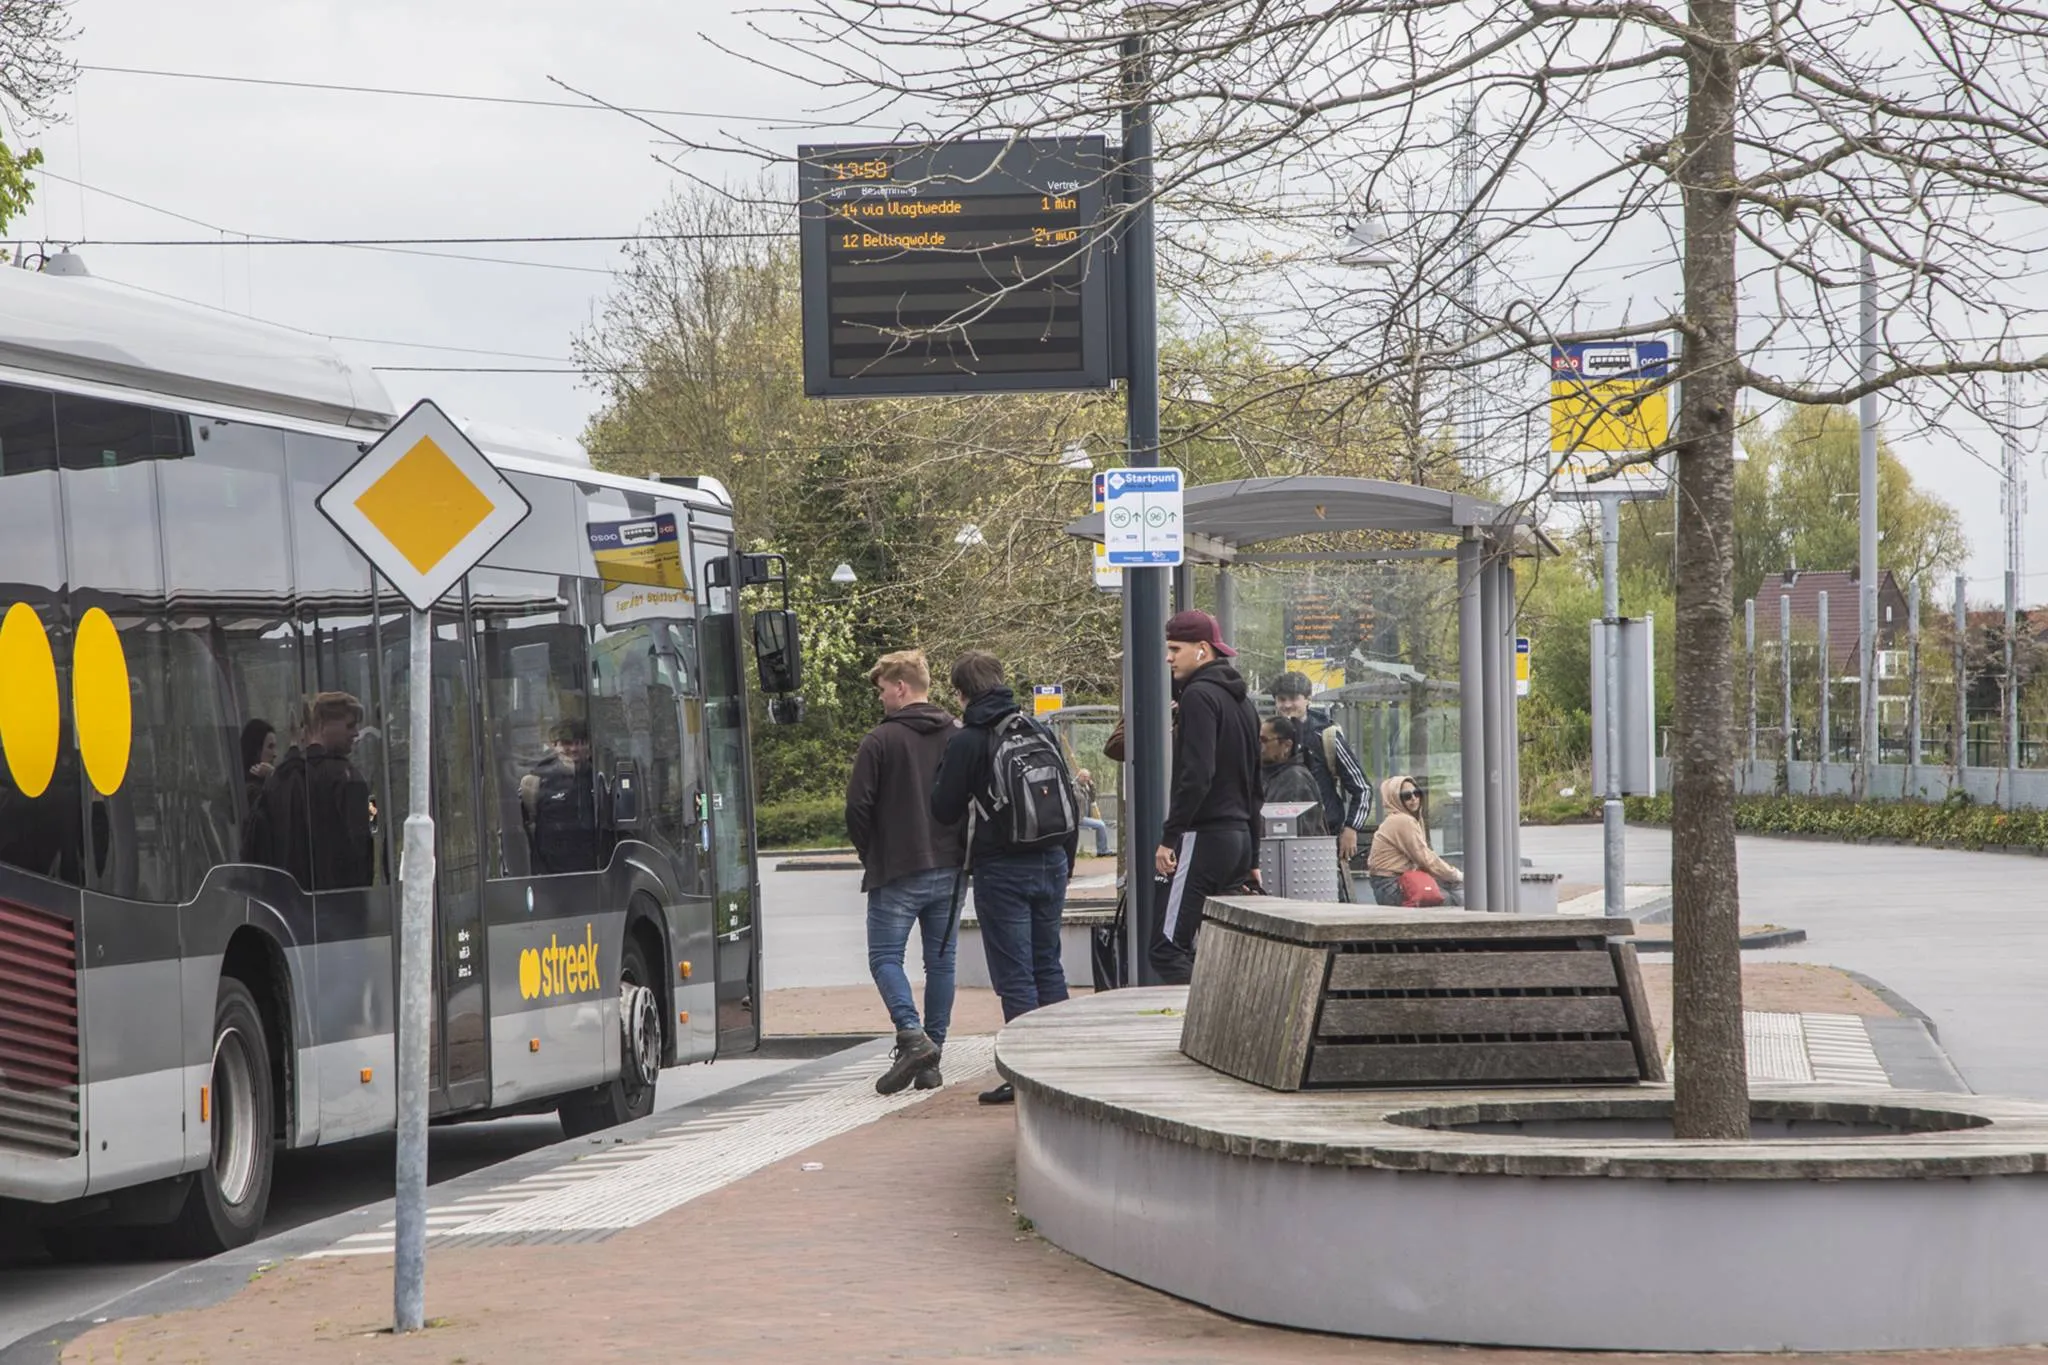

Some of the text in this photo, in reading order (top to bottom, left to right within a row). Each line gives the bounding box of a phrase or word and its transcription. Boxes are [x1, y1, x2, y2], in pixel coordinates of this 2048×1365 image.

[1047, 179, 1080, 190] Vertrek
[842, 197, 1077, 219] 14 via Vlagtwedde 1 min
[842, 234, 859, 248] 12
[863, 231, 946, 250] Bellingwolde
[1055, 229, 1077, 242] min
[1125, 472, 1176, 485] Startpunt
[1113, 512, 1127, 522] 96
[1149, 512, 1162, 522] 96
[541, 922, 601, 997] streek
